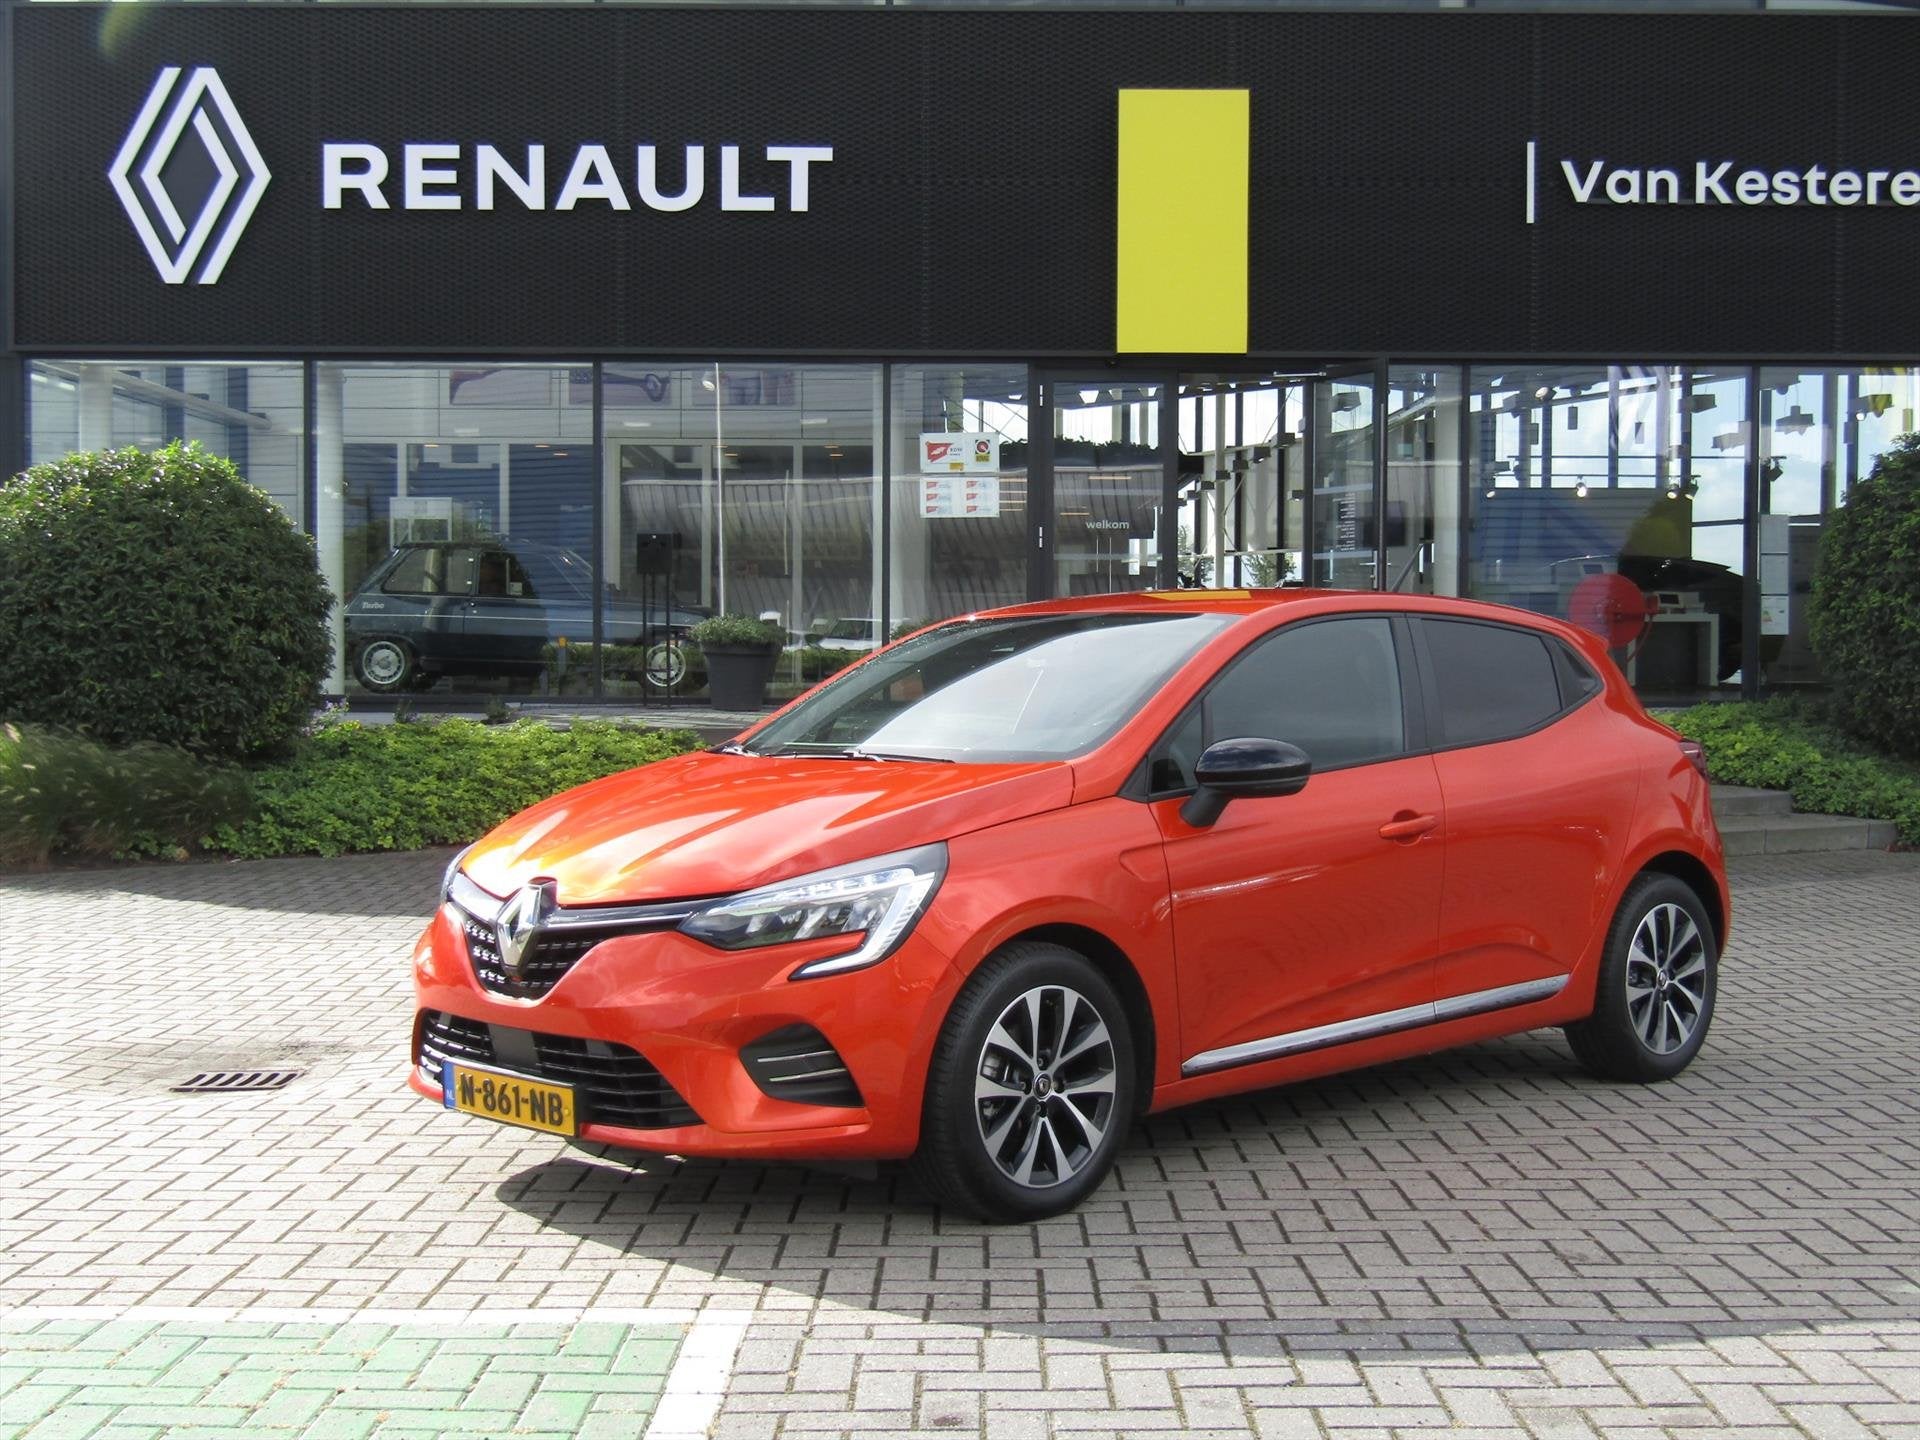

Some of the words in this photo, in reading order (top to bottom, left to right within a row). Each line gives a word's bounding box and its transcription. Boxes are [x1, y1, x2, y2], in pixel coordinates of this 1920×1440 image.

[323, 143, 834, 212] RENAULT
[1560, 160, 1679, 204] Van
[1695, 161, 1920, 206] Kestere
[1085, 519, 1130, 529] welkom
[362, 601, 385, 609] Turbo
[459, 1071, 564, 1127] N-861-NB
